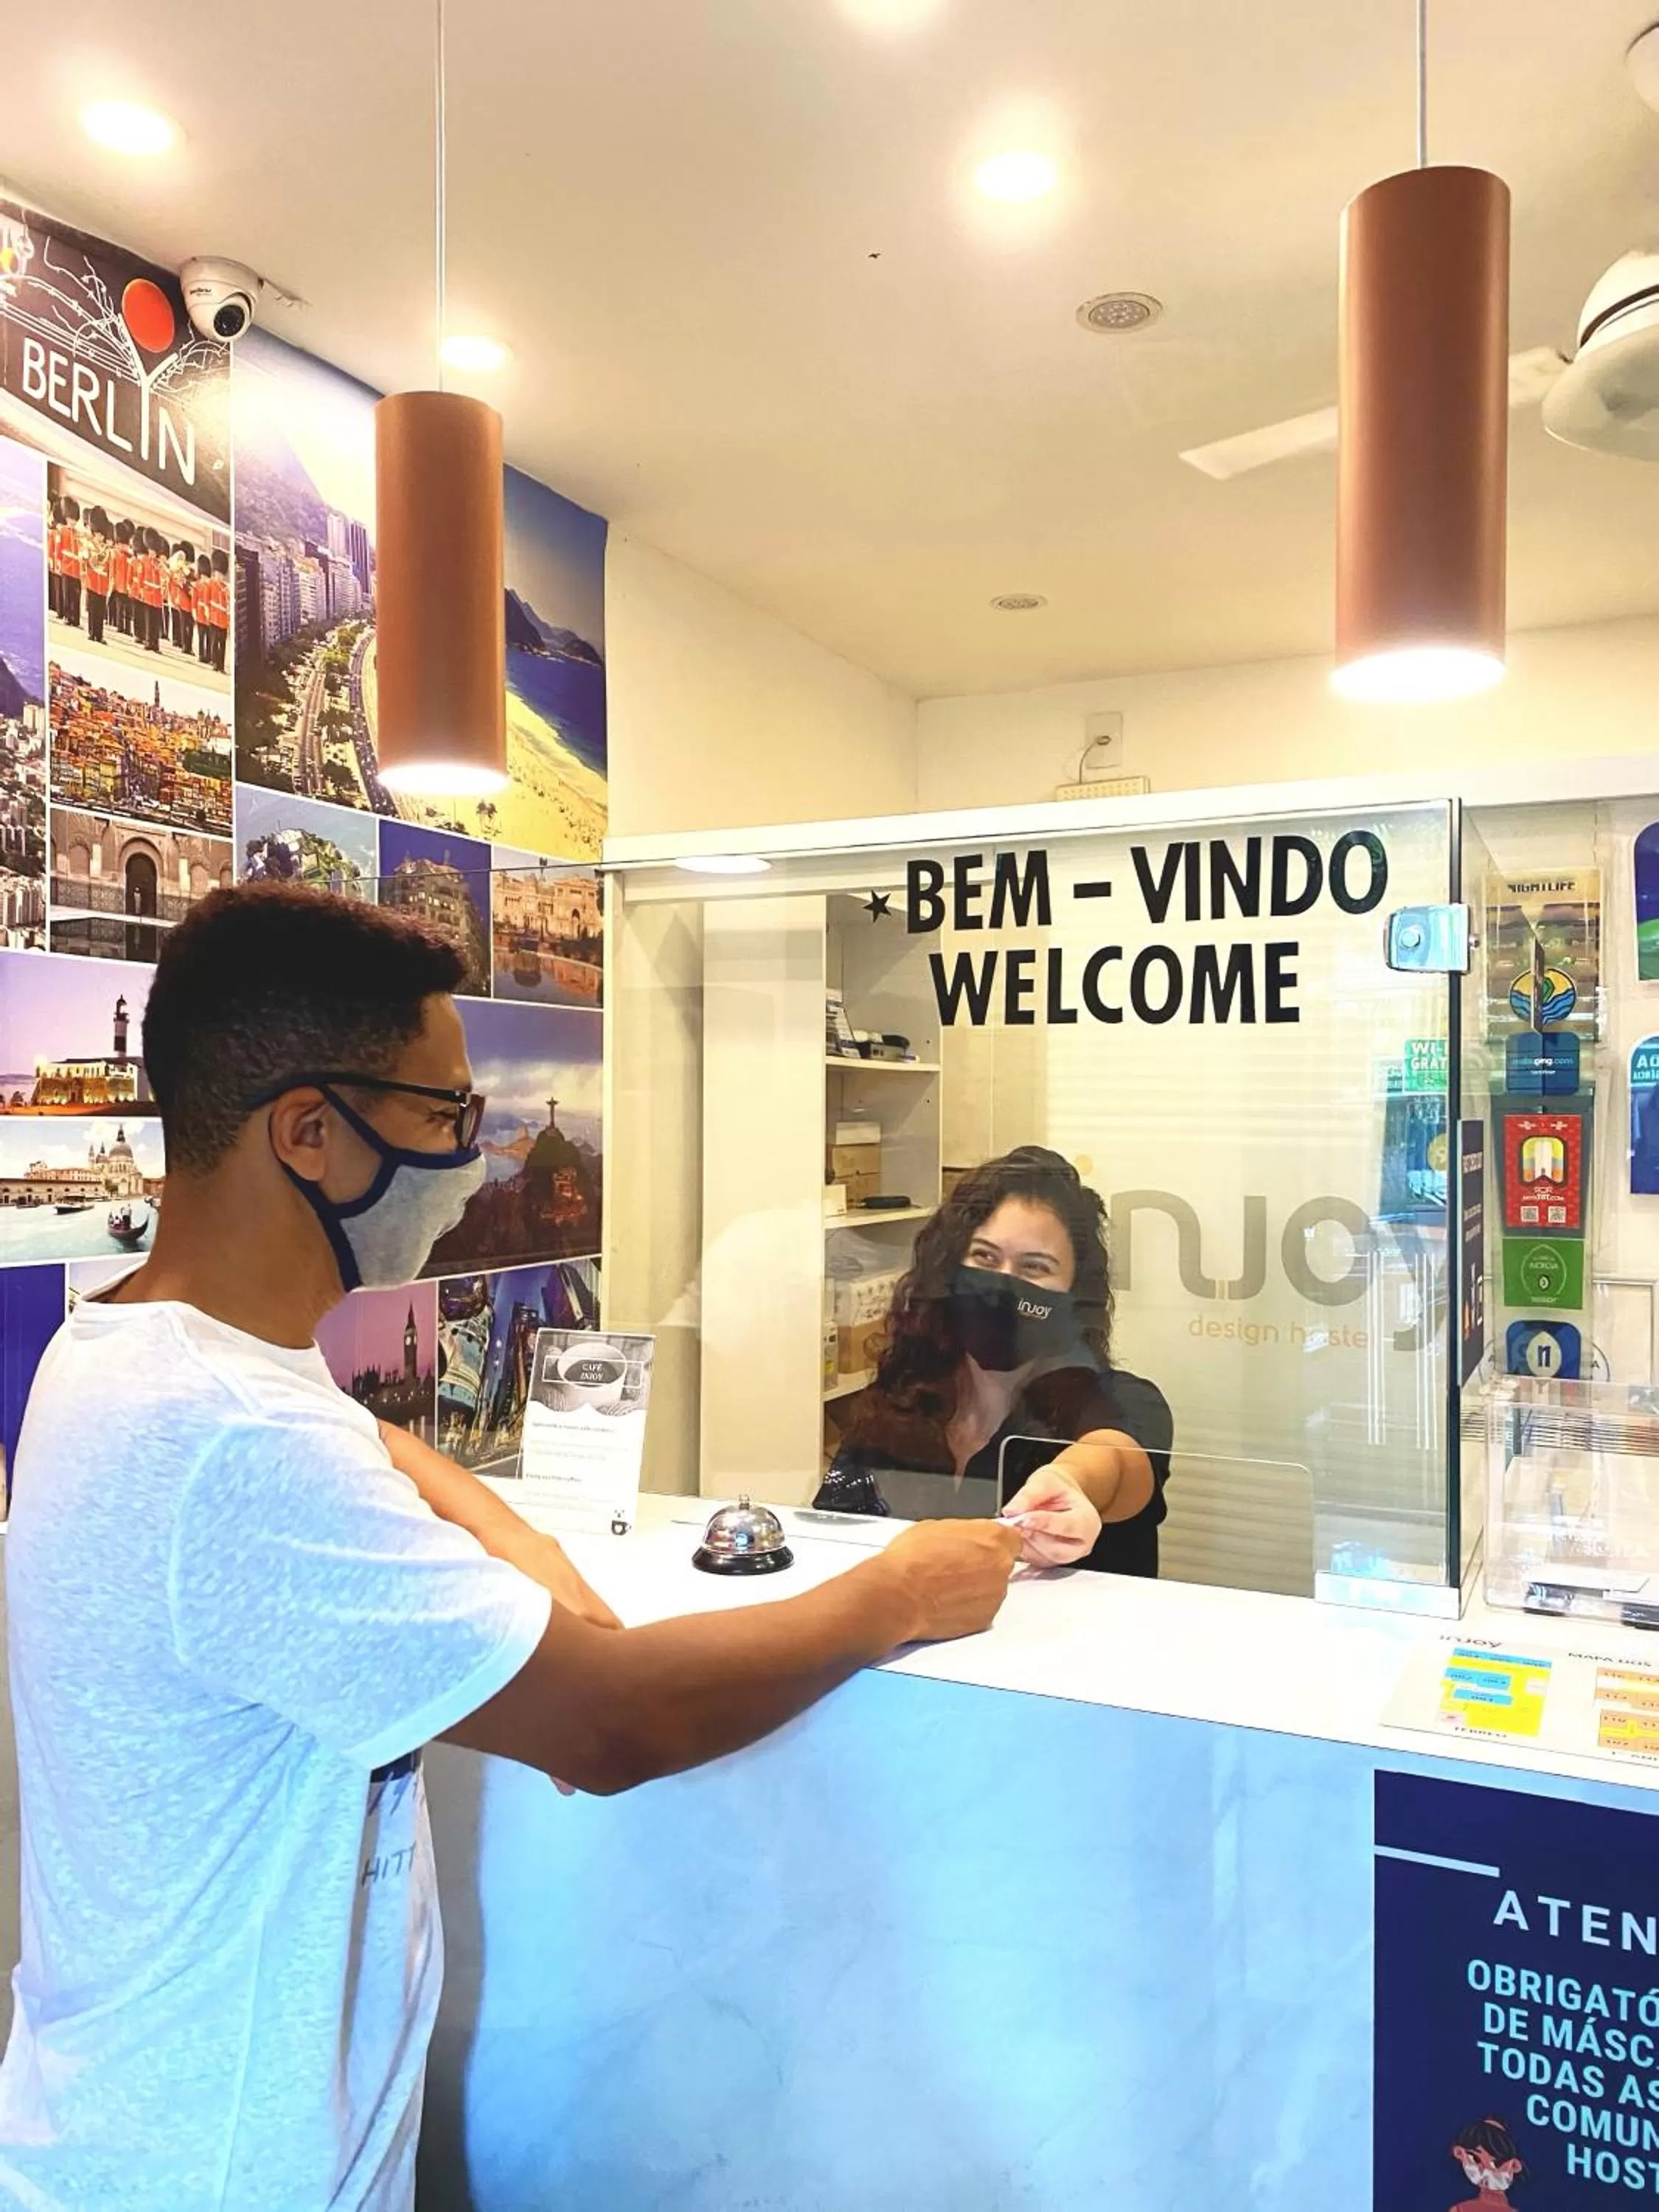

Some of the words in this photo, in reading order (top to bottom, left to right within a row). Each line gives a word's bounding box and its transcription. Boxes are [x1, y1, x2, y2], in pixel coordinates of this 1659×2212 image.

[22, 336, 195, 487] BERLIN
[907, 849, 1052, 934] BEM
[1130, 830, 1388, 924] VINDO
[929, 942, 1300, 1026] WELCOME
[1189, 1315, 1279, 1346] design
[1493, 1890, 1657, 1955] ATEN
[1467, 1958, 1659, 2028] OBRIGATÓ
[1484, 2002, 1528, 2041] DE
[1542, 2016, 1659, 2070] MÁSC
[1478, 2041, 1605, 2098] TODAS
[1618, 2073, 1659, 2112] AS
